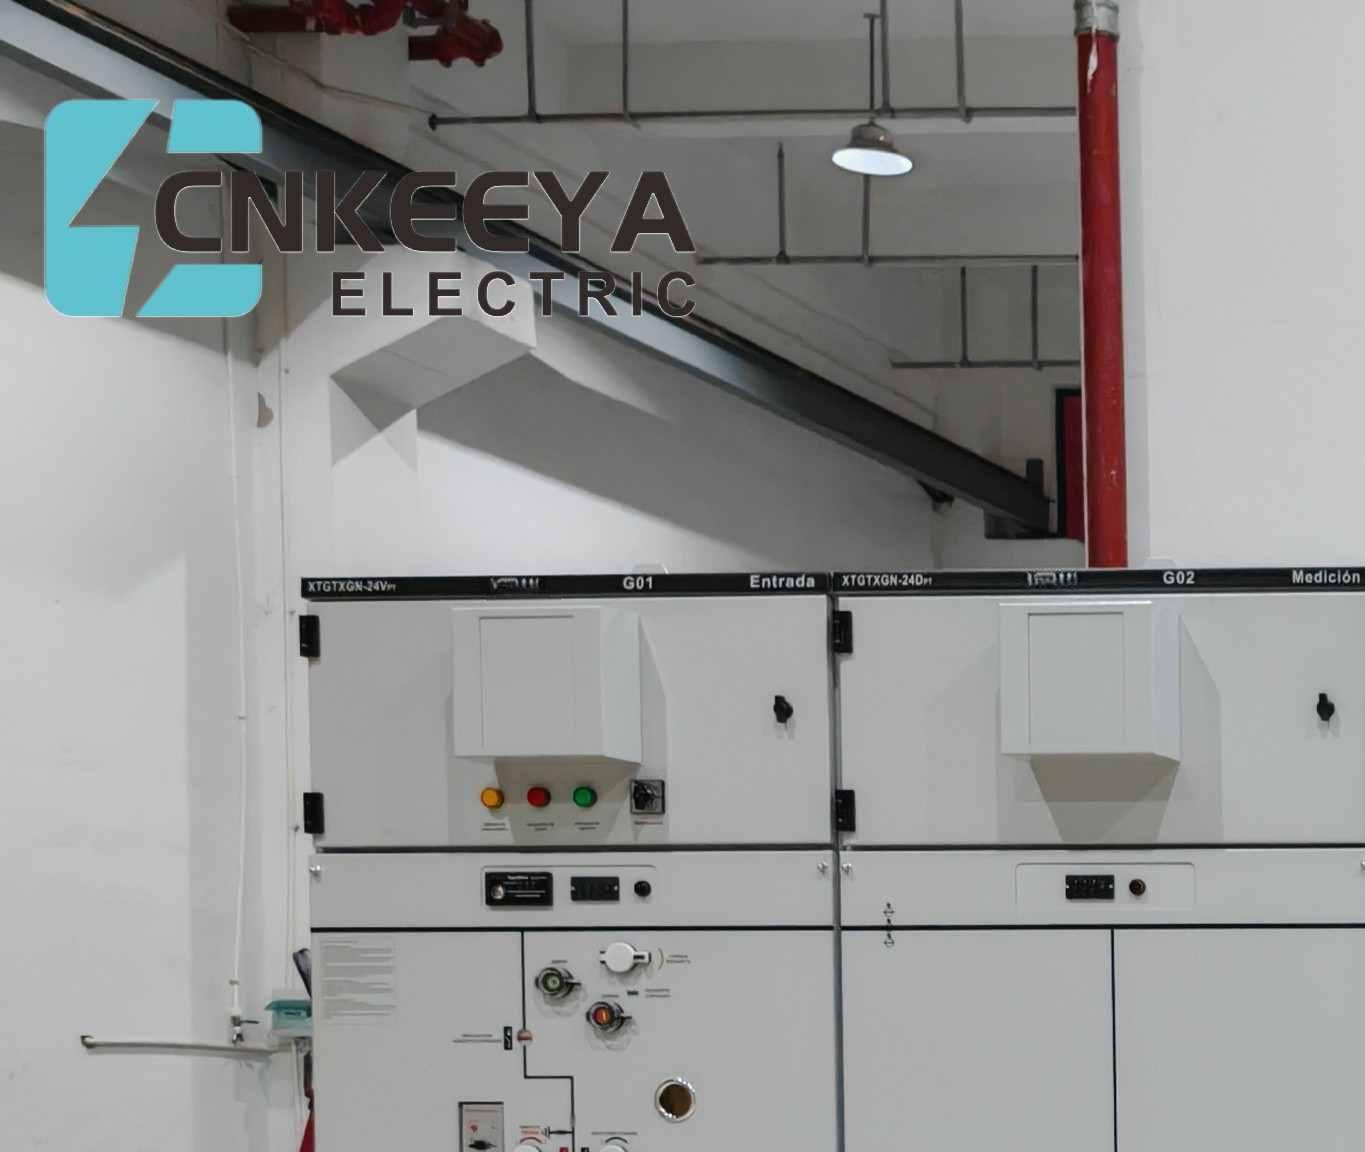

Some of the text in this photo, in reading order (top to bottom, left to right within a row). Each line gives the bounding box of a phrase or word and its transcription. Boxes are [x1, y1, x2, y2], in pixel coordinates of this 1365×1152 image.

[623, 576, 654, 590] G01
[749, 575, 815, 589] Entrada
[1162, 571, 1196, 584] G02
[1291, 570, 1361, 584] Medición
